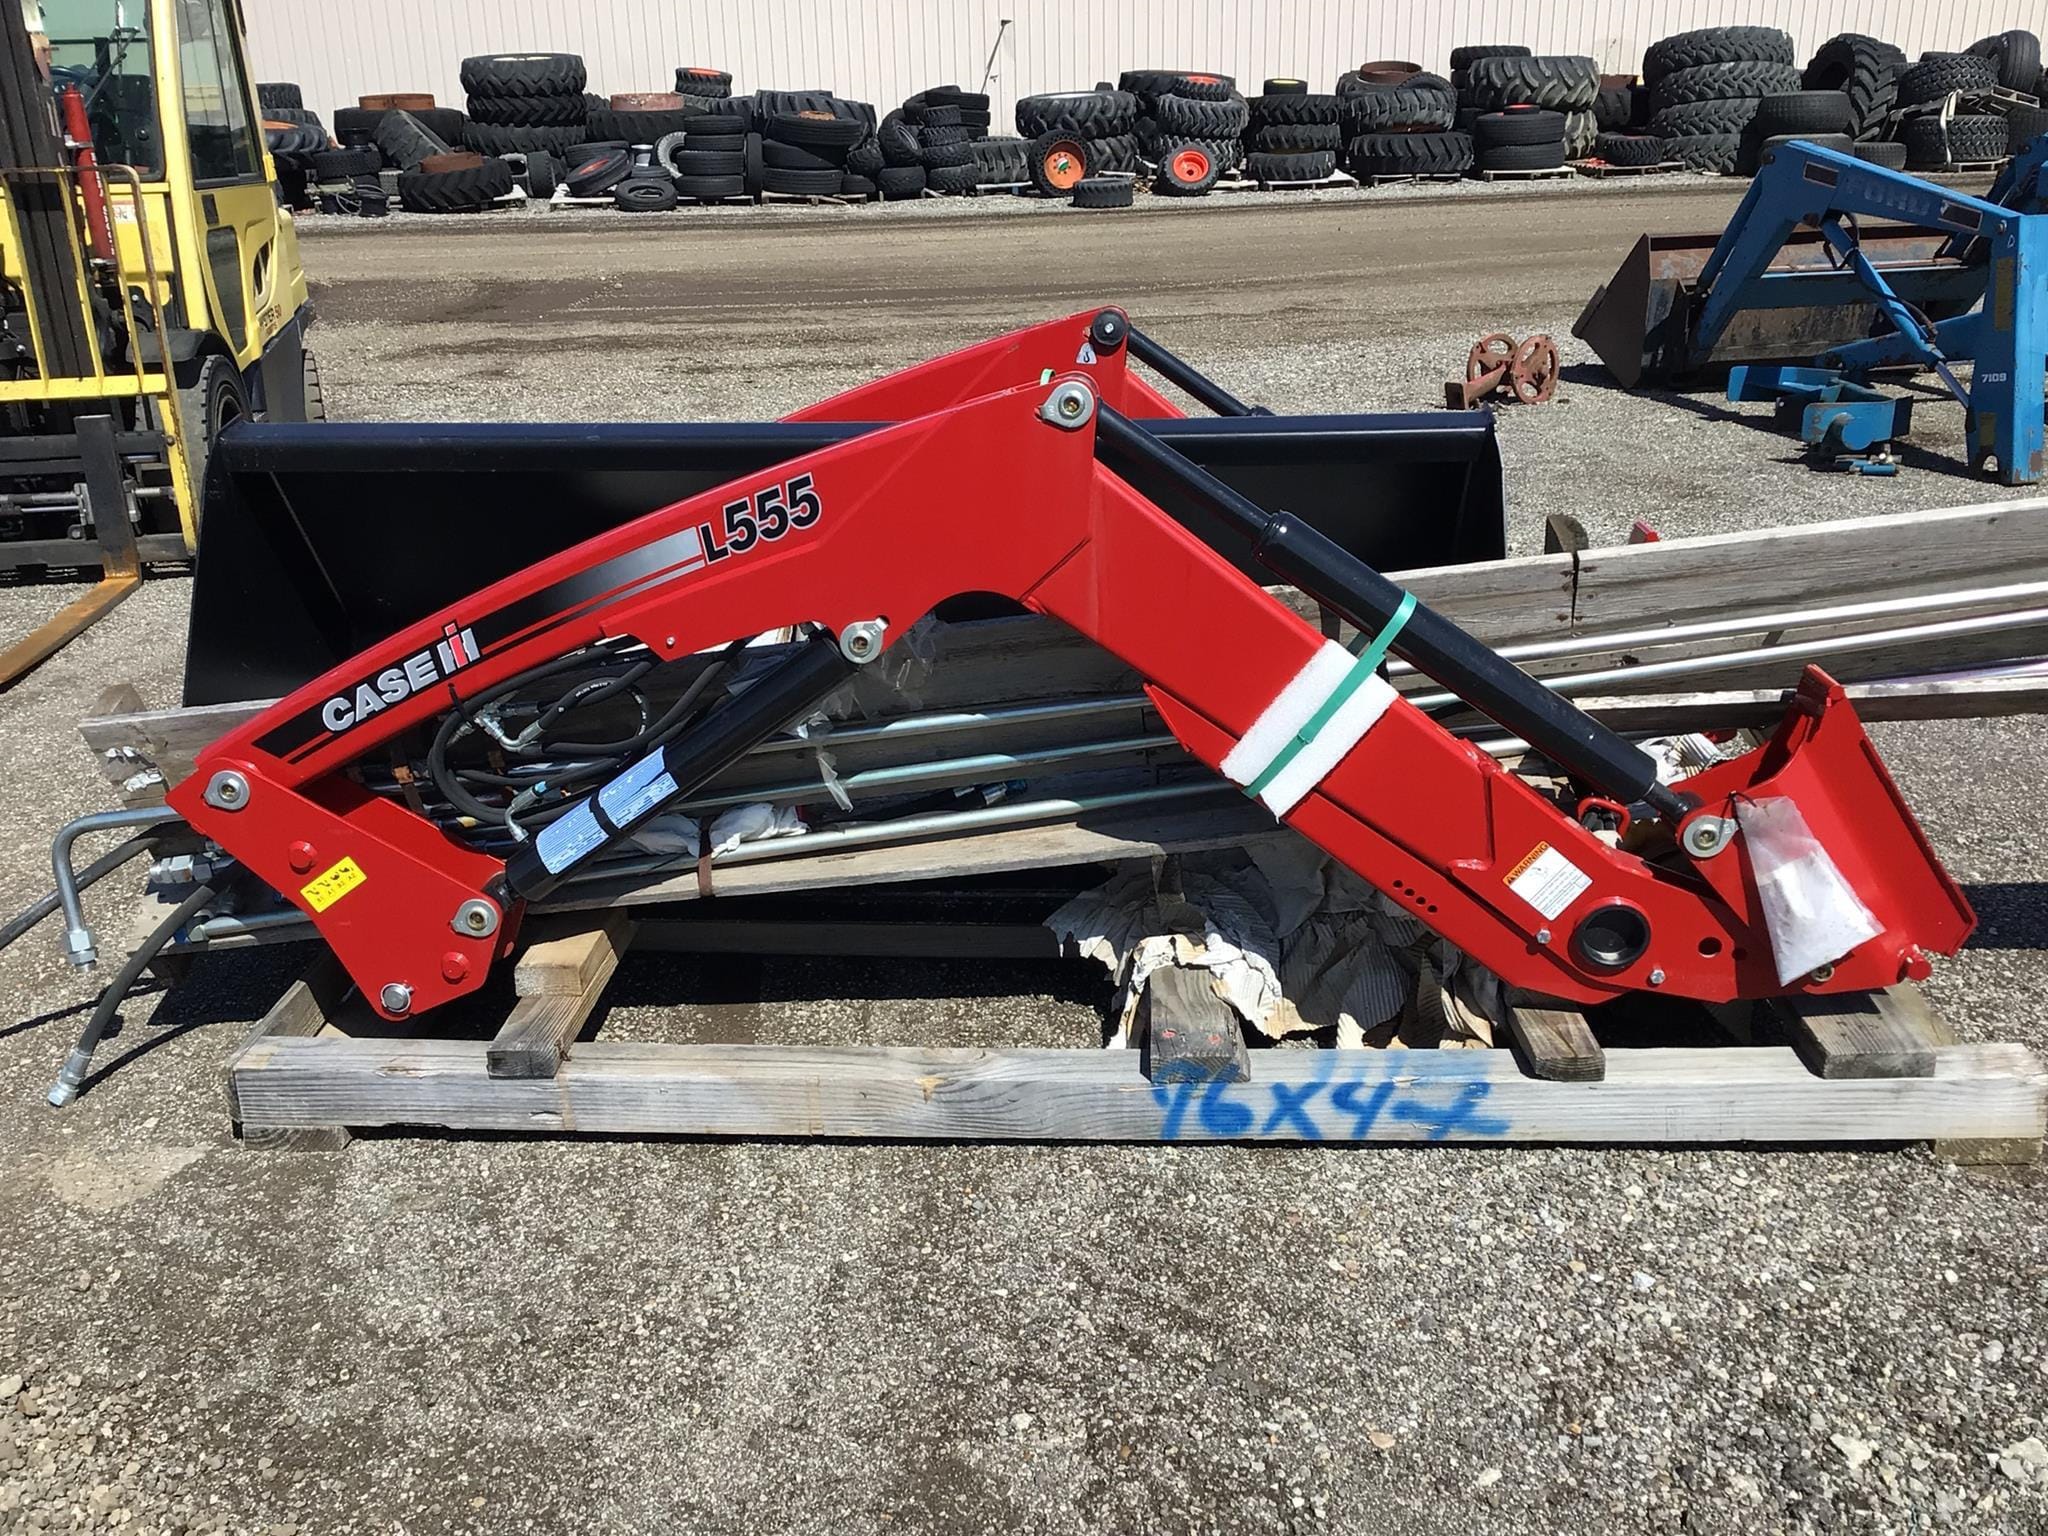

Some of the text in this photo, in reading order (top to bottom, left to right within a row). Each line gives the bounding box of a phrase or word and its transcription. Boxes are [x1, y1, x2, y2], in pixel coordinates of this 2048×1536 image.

[1981, 372, 2007, 384] 7109
[698, 472, 822, 565] L555
[322, 650, 439, 732] CASE
[1511, 842, 1549, 878] WARNING
